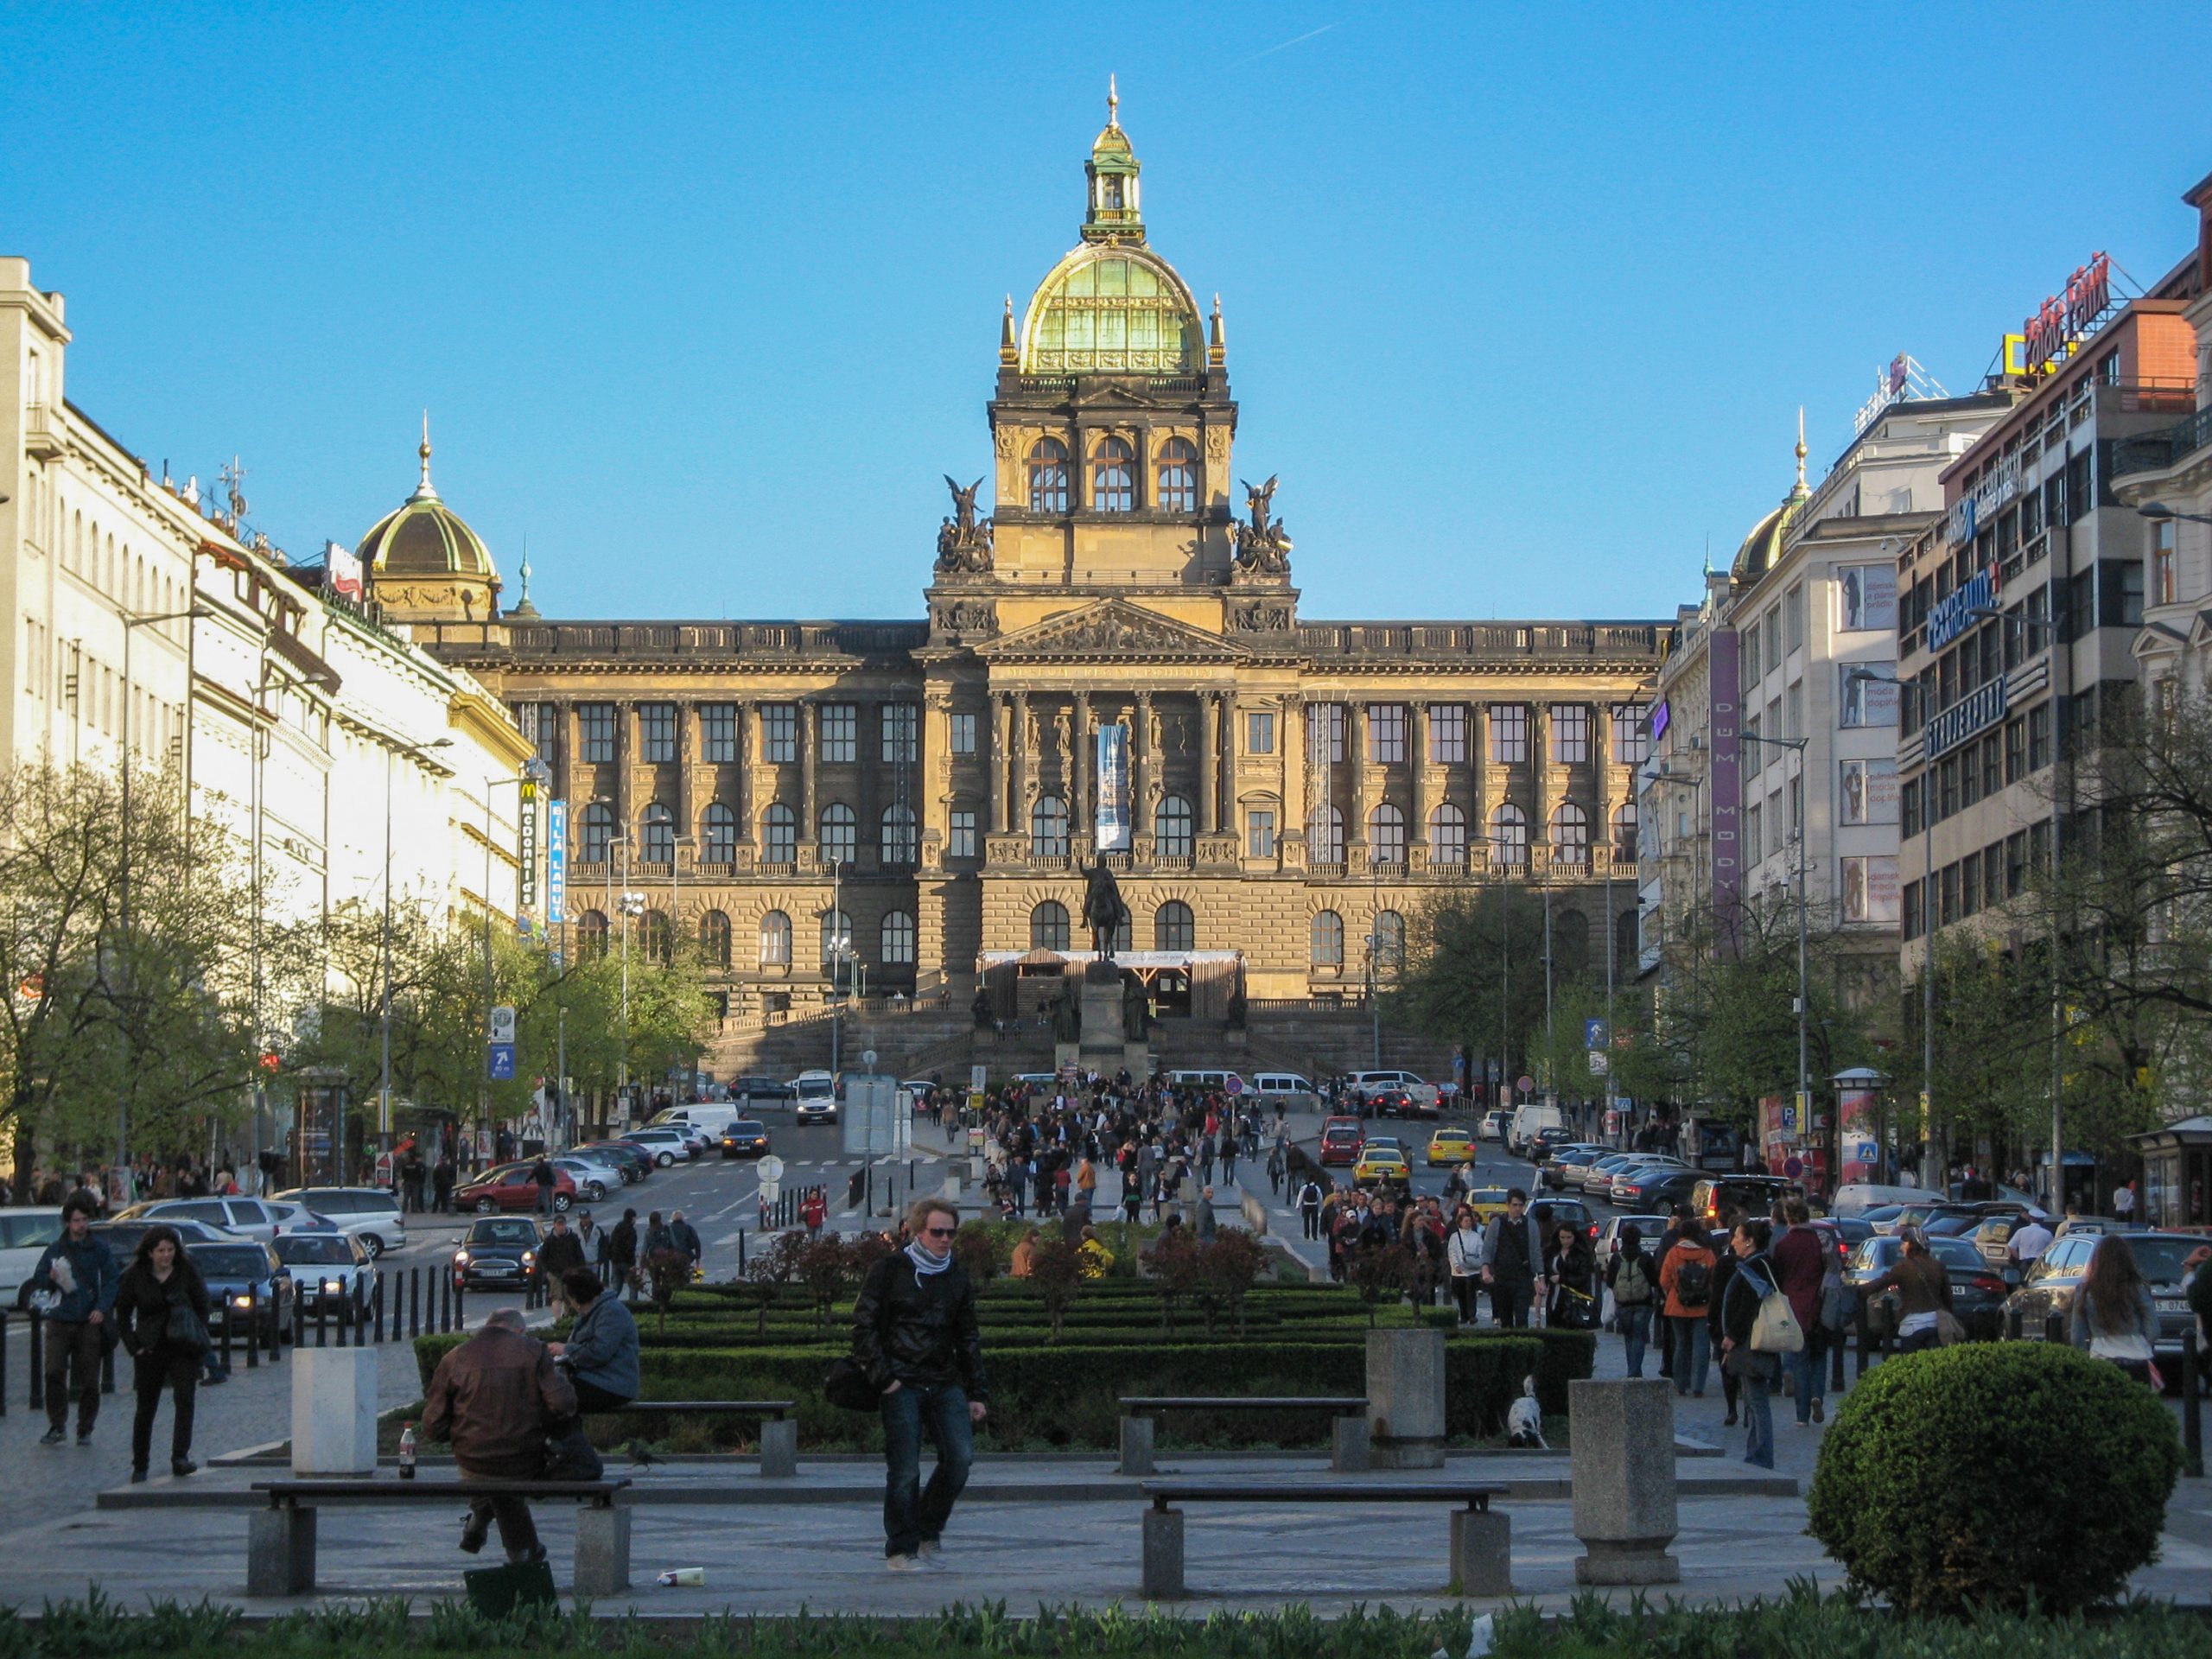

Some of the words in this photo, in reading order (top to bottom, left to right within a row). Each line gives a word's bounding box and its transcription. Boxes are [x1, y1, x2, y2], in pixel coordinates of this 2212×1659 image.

[552, 805, 563, 851] BÍLÁ
[522, 803, 534, 904] McDonald's
[1784, 1107, 1795, 1121] P
